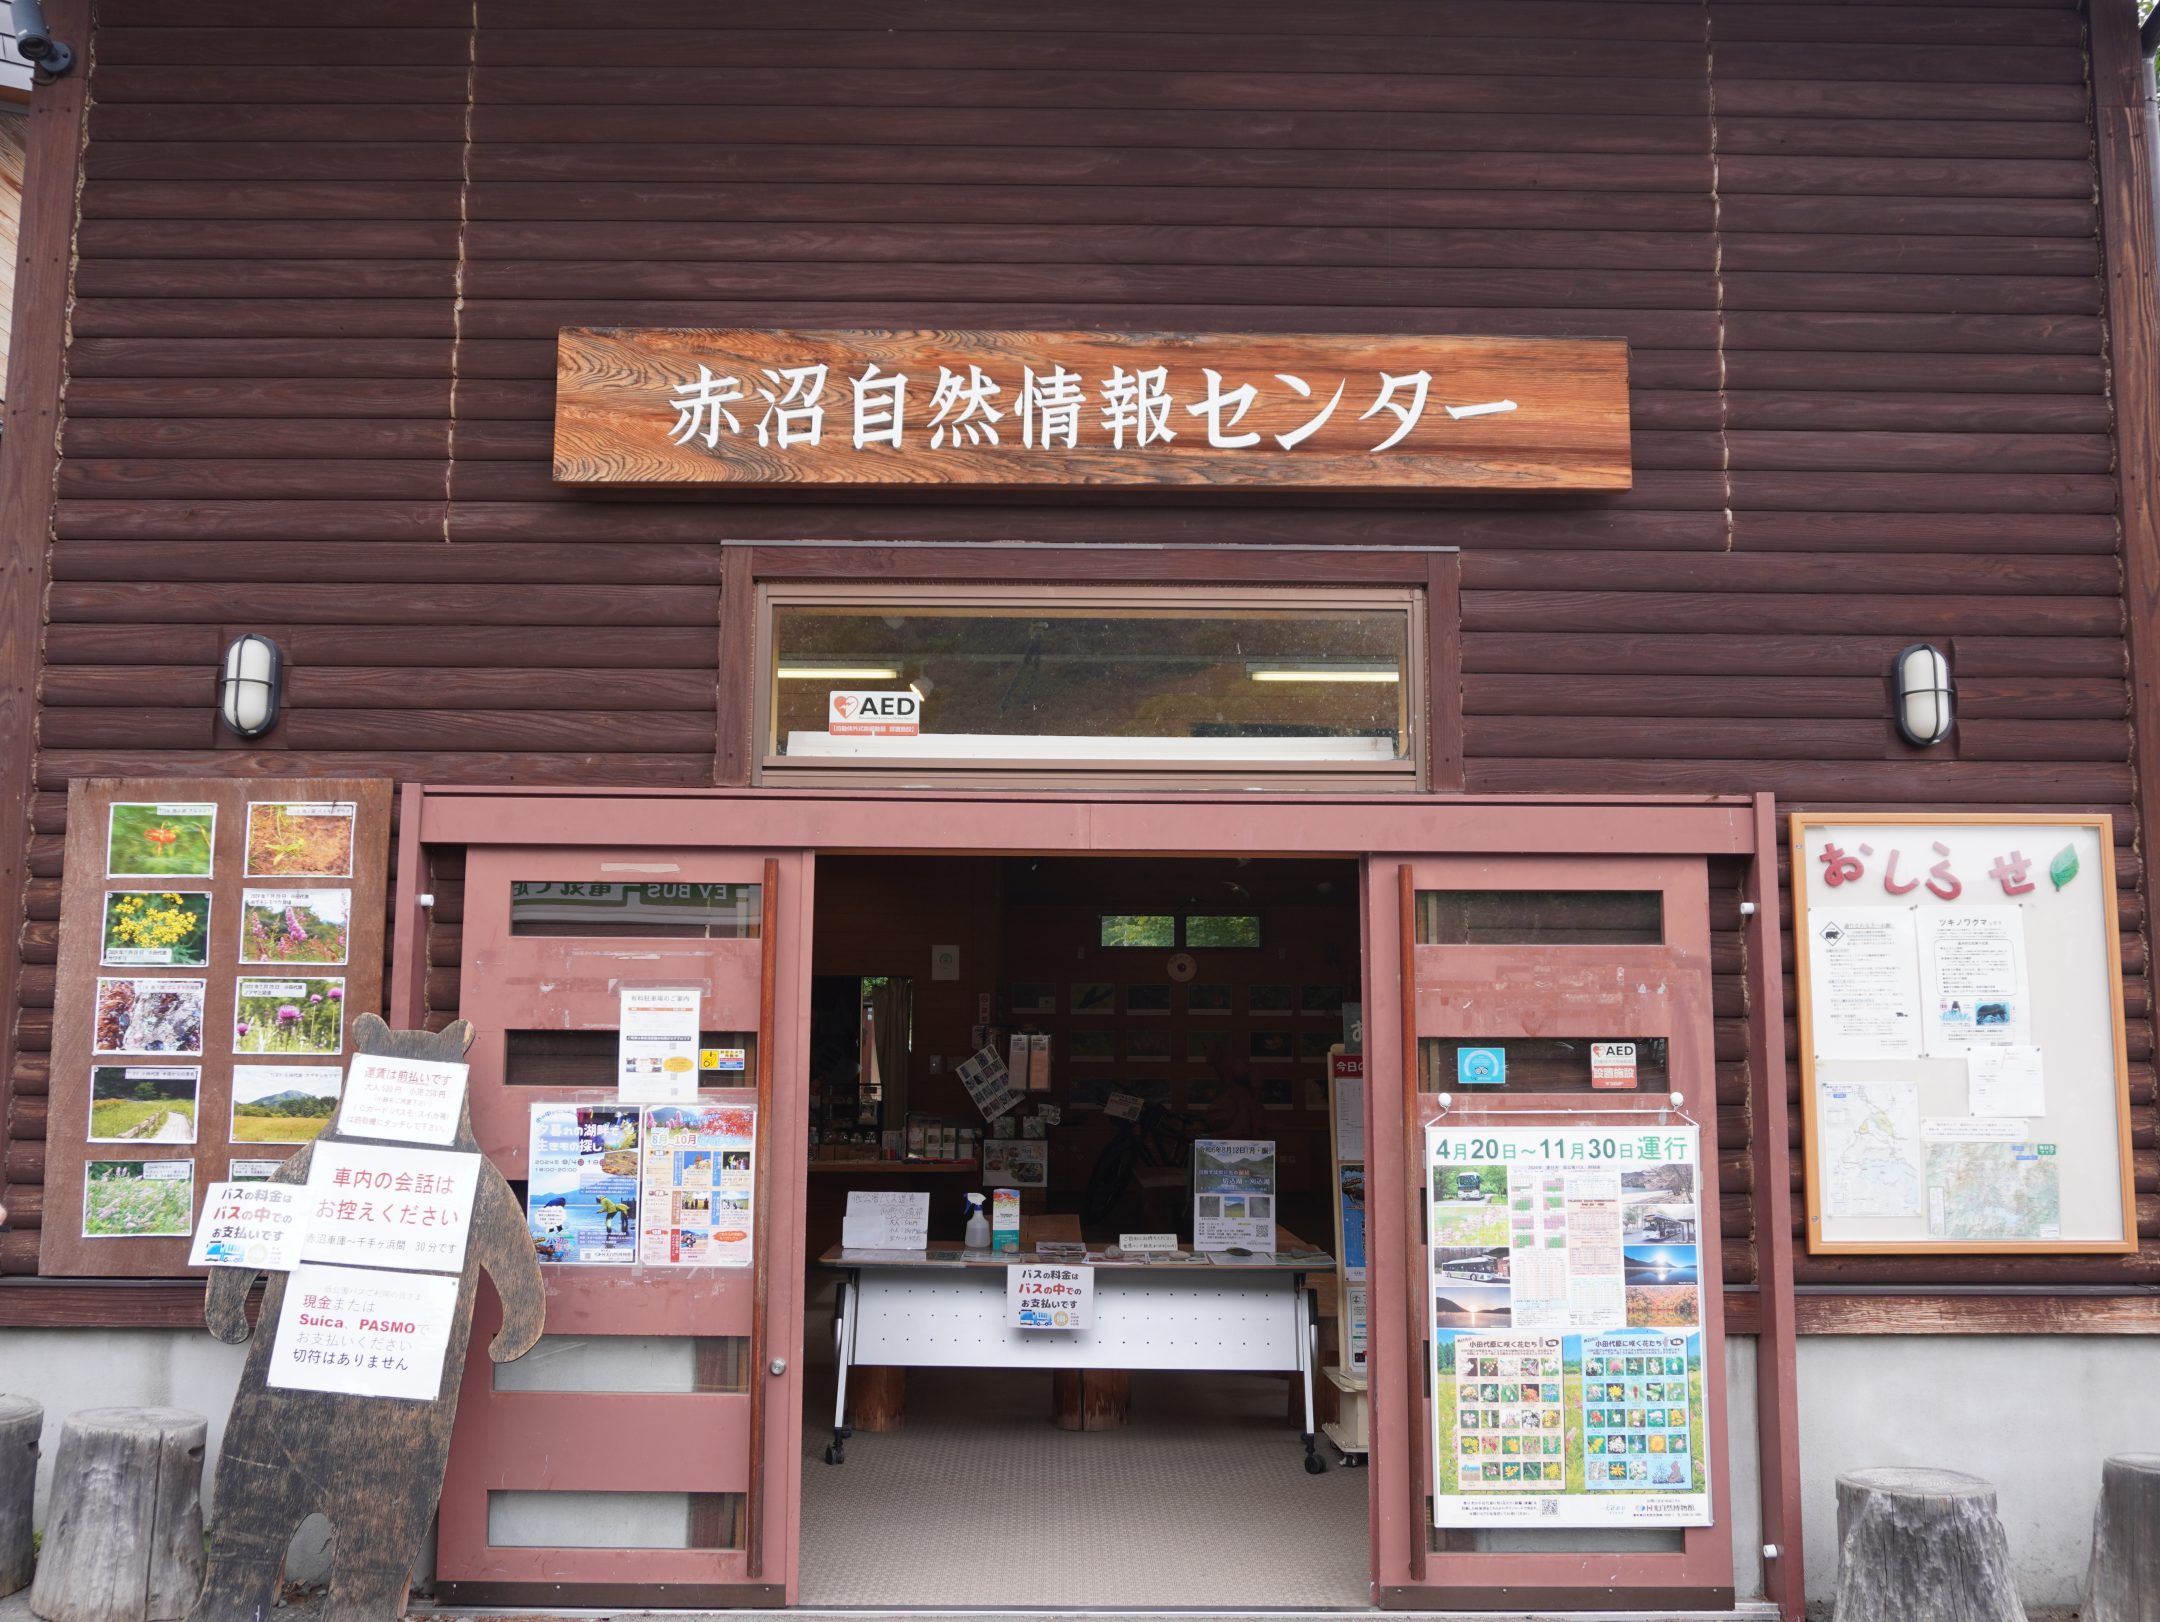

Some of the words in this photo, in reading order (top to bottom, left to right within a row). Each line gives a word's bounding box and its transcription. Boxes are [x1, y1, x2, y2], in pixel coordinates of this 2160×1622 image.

[667, 361, 1519, 453] 赤沼自然情報センター
[859, 697, 915, 716] AED
[1818, 840, 2036, 901] おしらせ
[1606, 1046, 1634, 1056] AED
[364, 1066, 453, 1087] 運賃は前払いです
[332, 1167, 456, 1195] 車内の会話は
[221, 1188, 293, 1204] バスの料金は
[212, 1205, 294, 1224] バスの中での
[315, 1197, 460, 1227] お控えください
[211, 1225, 285, 1242] お支払いです
[1021, 1269, 1079, 1281] バスの料金は
[1018, 1282, 1082, 1296] バスの中での
[302, 1294, 376, 1314] 現金または
[1020, 1298, 1078, 1310] お支払いです
[296, 1331, 413, 1352] お支払いください
[292, 1347, 409, 1372] 切符はありません
